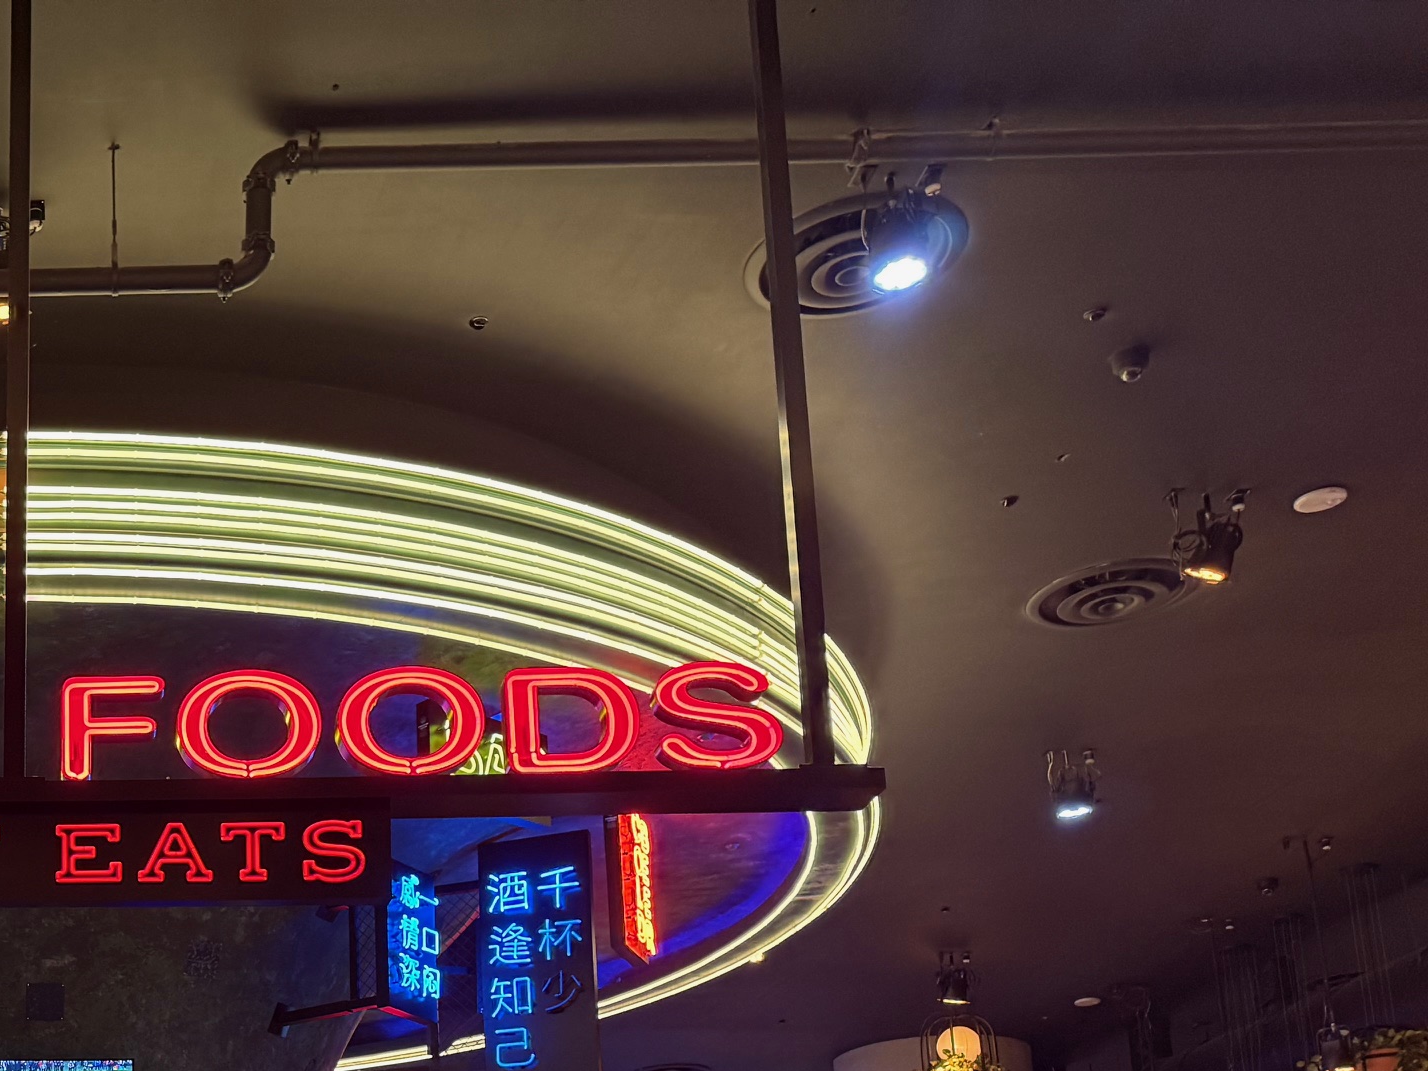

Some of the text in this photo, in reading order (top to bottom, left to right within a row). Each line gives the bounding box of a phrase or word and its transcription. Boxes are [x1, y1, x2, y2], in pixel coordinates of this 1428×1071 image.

[60, 660, 784, 781] FOODS
[54, 819, 366, 885] EATS
[487, 871, 536, 1069] 酒逢知己
[537, 865, 583, 1013] 千杯少
